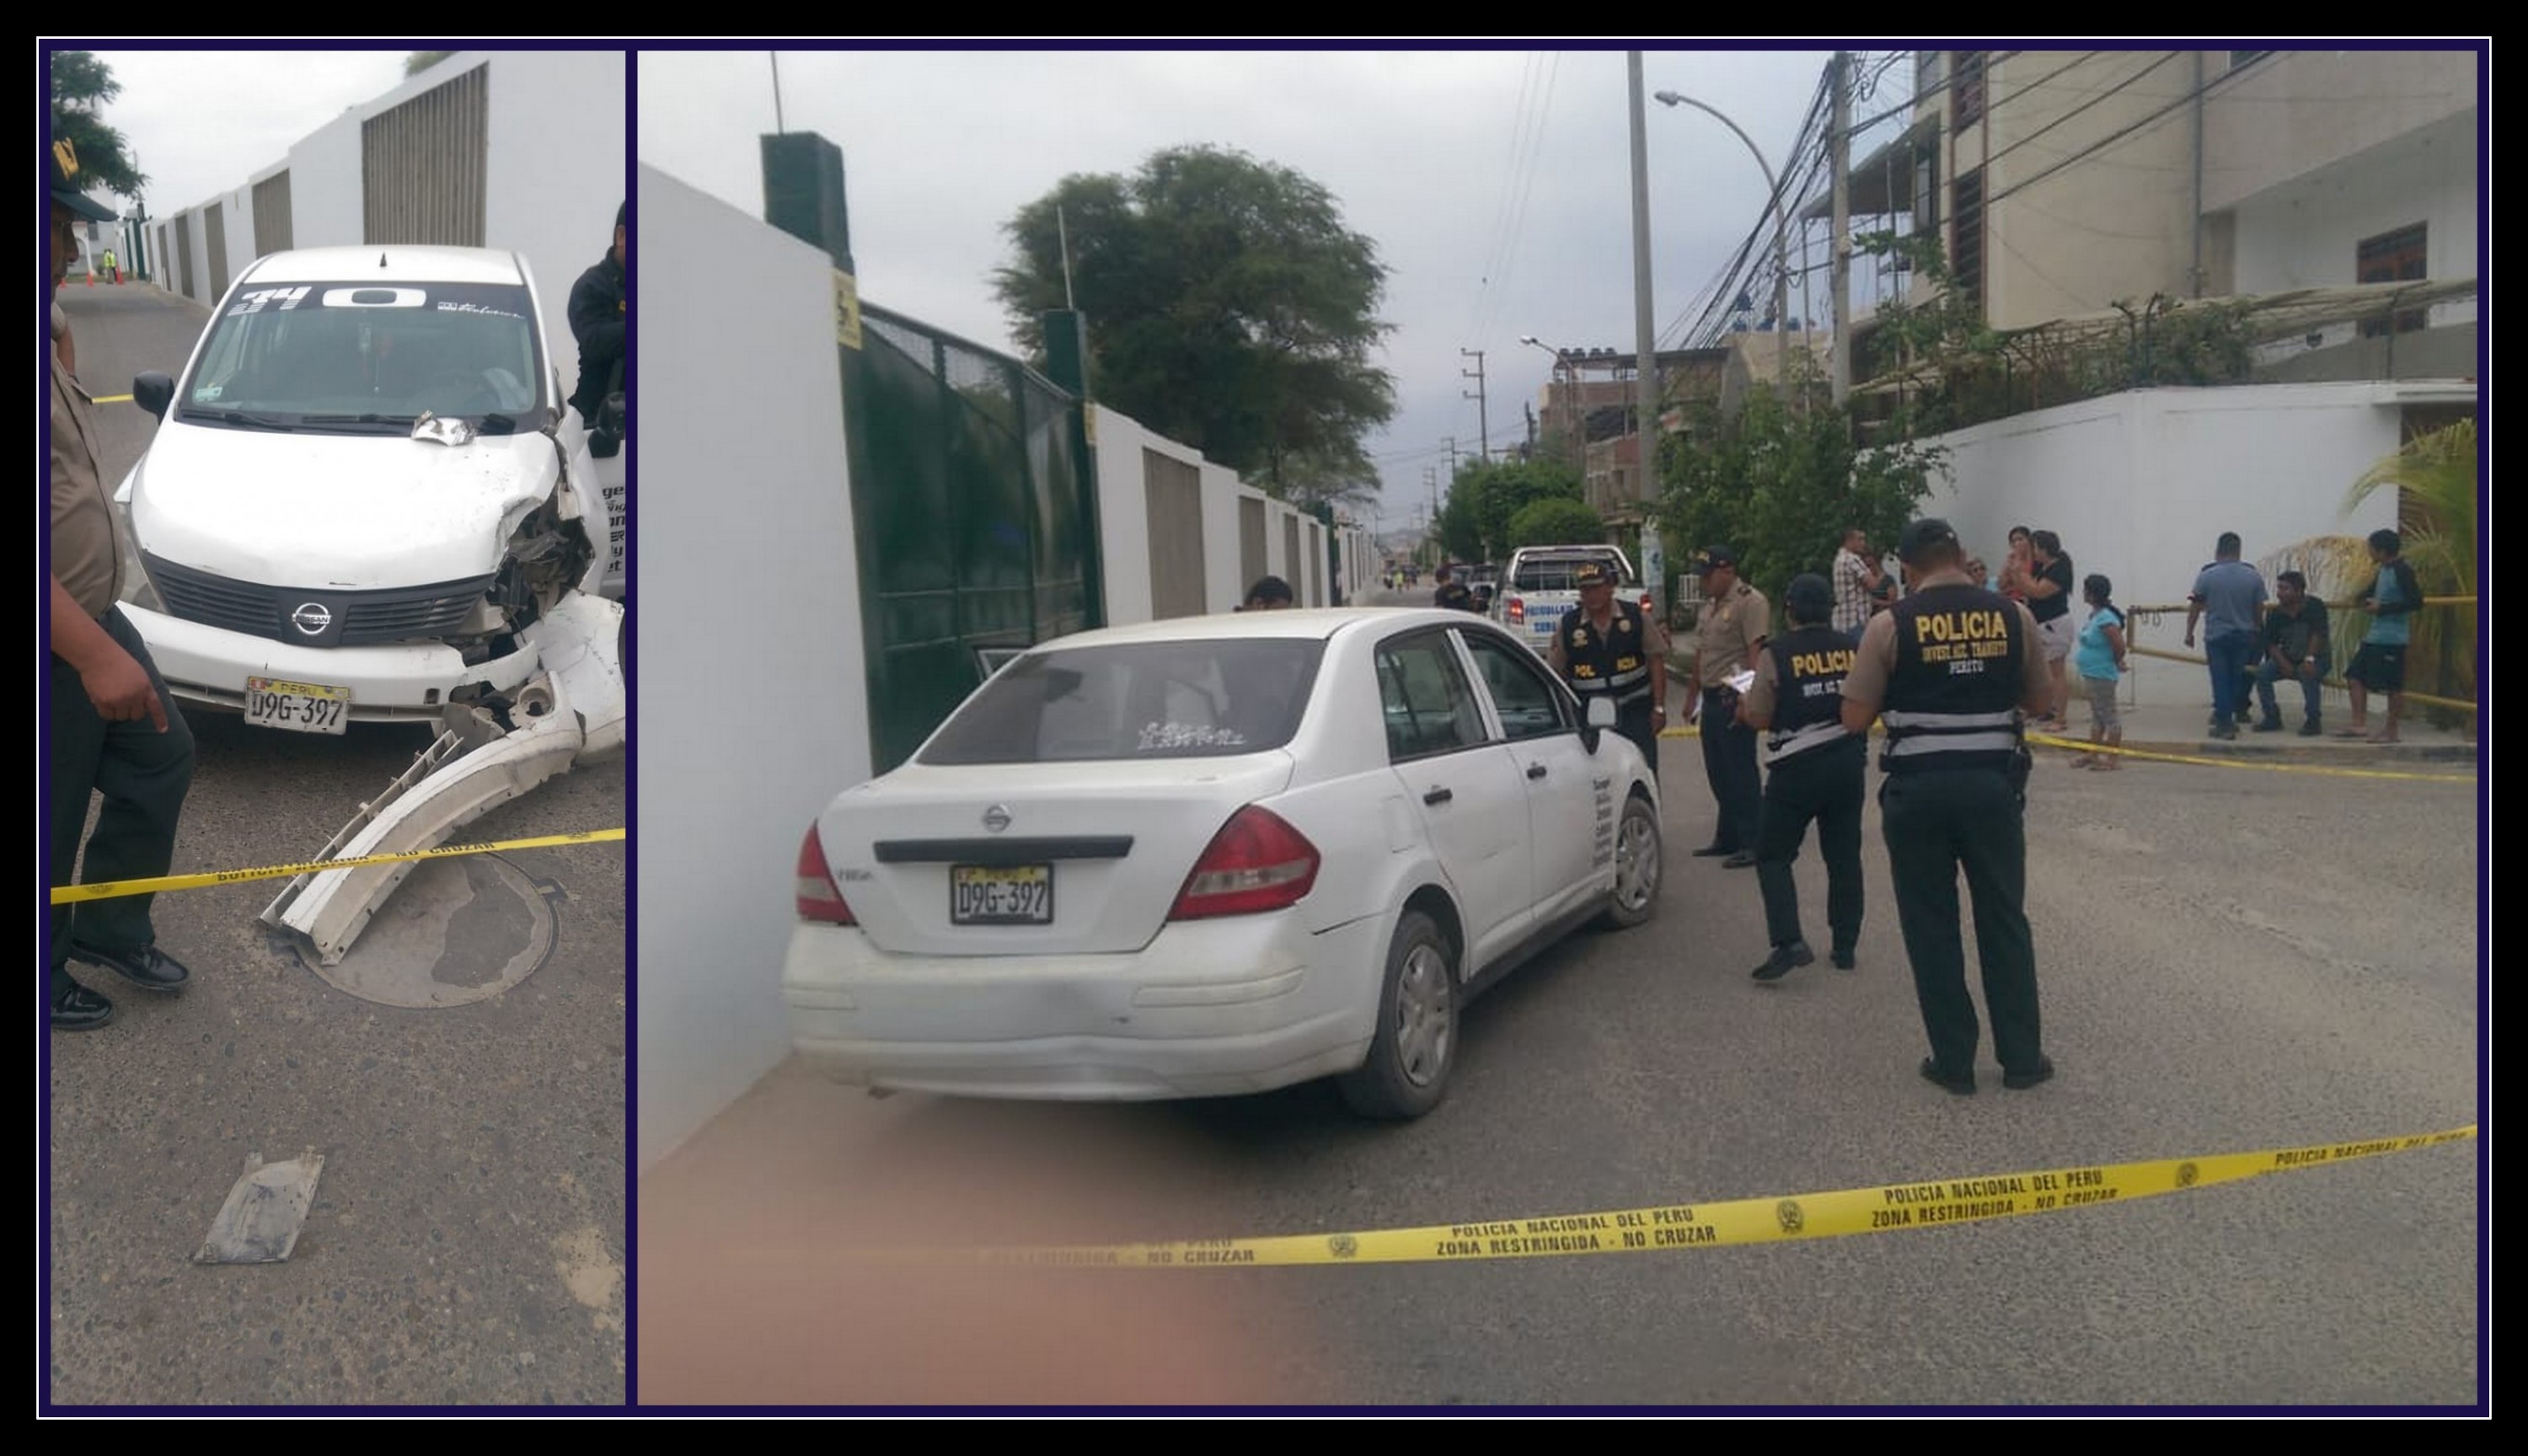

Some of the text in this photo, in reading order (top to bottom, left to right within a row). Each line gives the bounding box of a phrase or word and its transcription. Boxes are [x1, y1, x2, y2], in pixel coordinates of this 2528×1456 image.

[1916, 610, 2008, 643] POLICIA
[281, 682, 317, 696] PERU
[251, 691, 345, 727] D9G-397
[958, 881, 1047, 913] D9G-397
[2276, 1148, 2327, 1166] POLICIA
[1884, 1170, 2103, 1205] POLICIA NACIONAL DEL PERU
[1452, 1207, 1695, 1238] POLICIA NACIONAL DEL PERU
[1872, 1208, 1911, 1228] ZONA
[1919, 1199, 2015, 1223] RESTRINGIDA
[2034, 1195, 2055, 1210] NO
[2064, 1187, 2118, 1206] CRUZAR
[1436, 1239, 1481, 1256] ZONA
[1490, 1234, 1600, 1255] RESTRINGIDA
[1623, 1231, 1647, 1248] NO
[1654, 1225, 1717, 1246] CRUZAR
[1147, 1250, 1172, 1264] NO
[1183, 1249, 1255, 1264] CRUZAR
